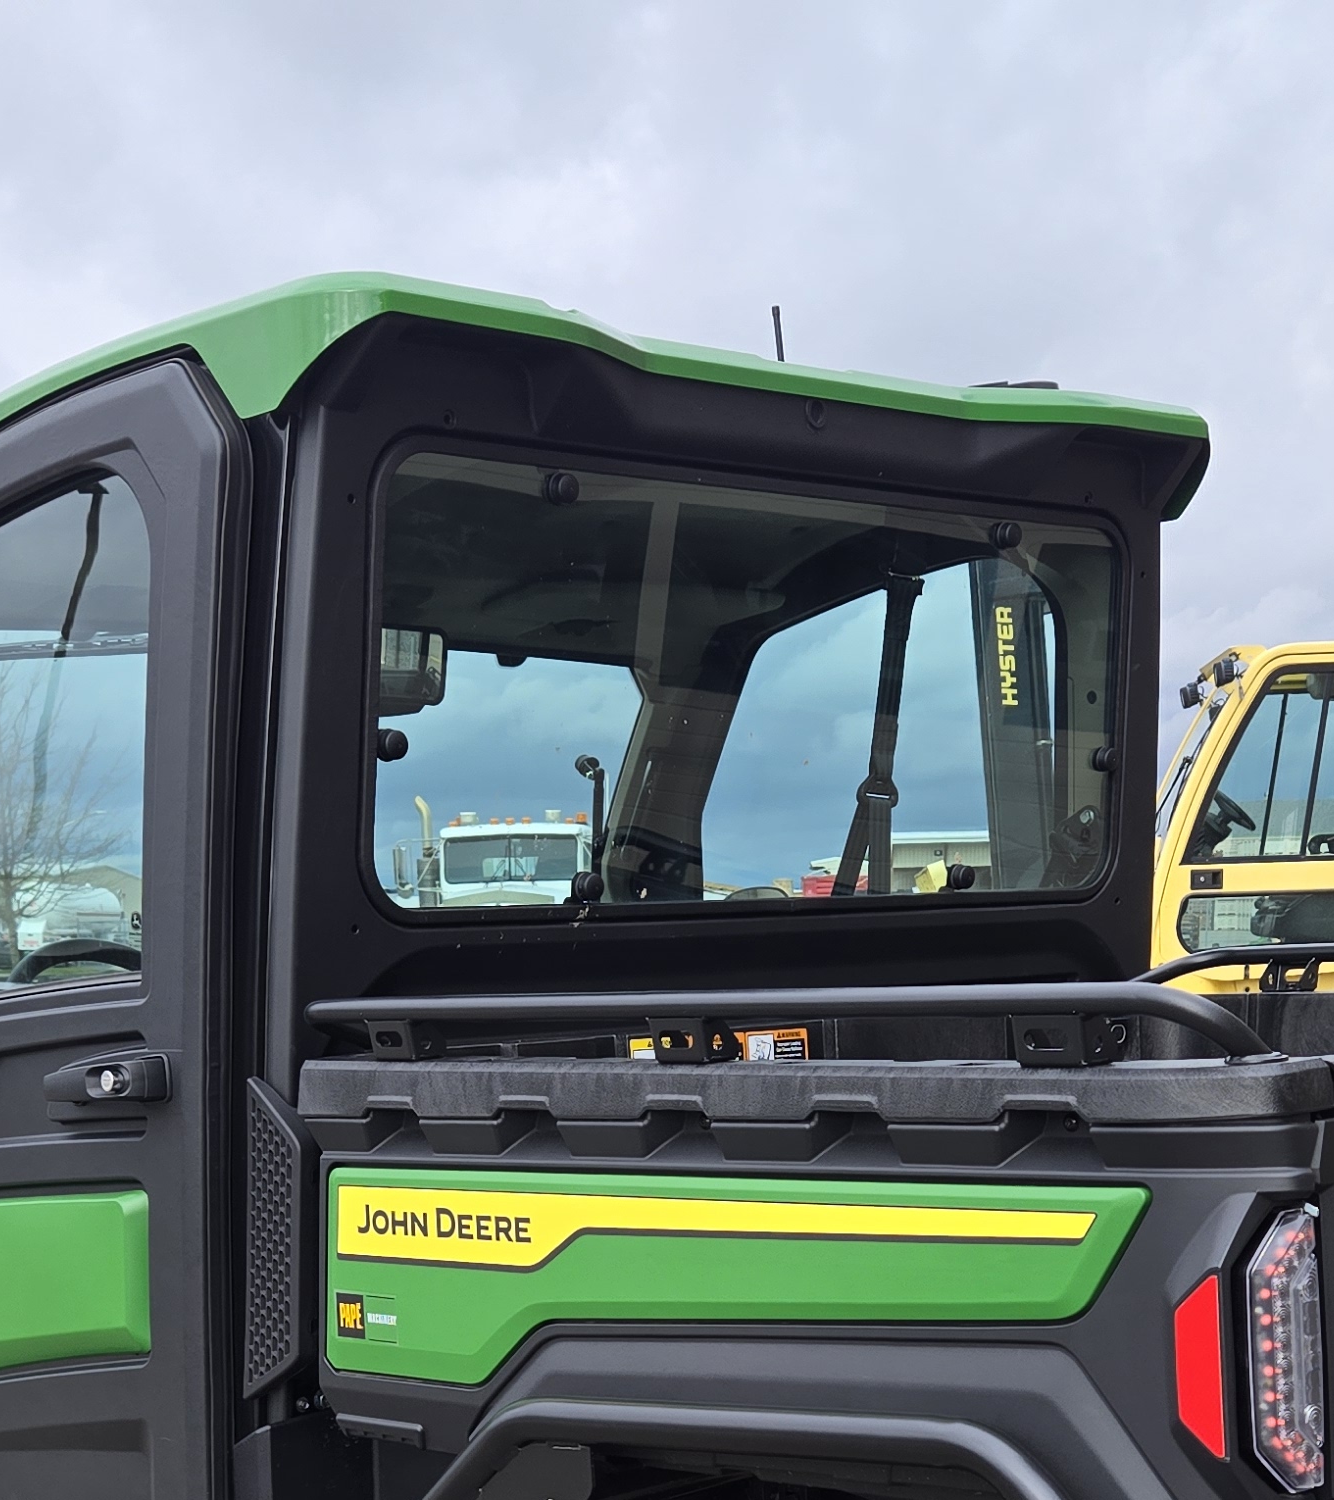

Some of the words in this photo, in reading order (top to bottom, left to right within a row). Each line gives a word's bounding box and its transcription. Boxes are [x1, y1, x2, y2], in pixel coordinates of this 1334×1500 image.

[995, 606, 1019, 706] HYSTER
[357, 1204, 429, 1237] JOHN
[435, 1207, 532, 1243] DEERE
